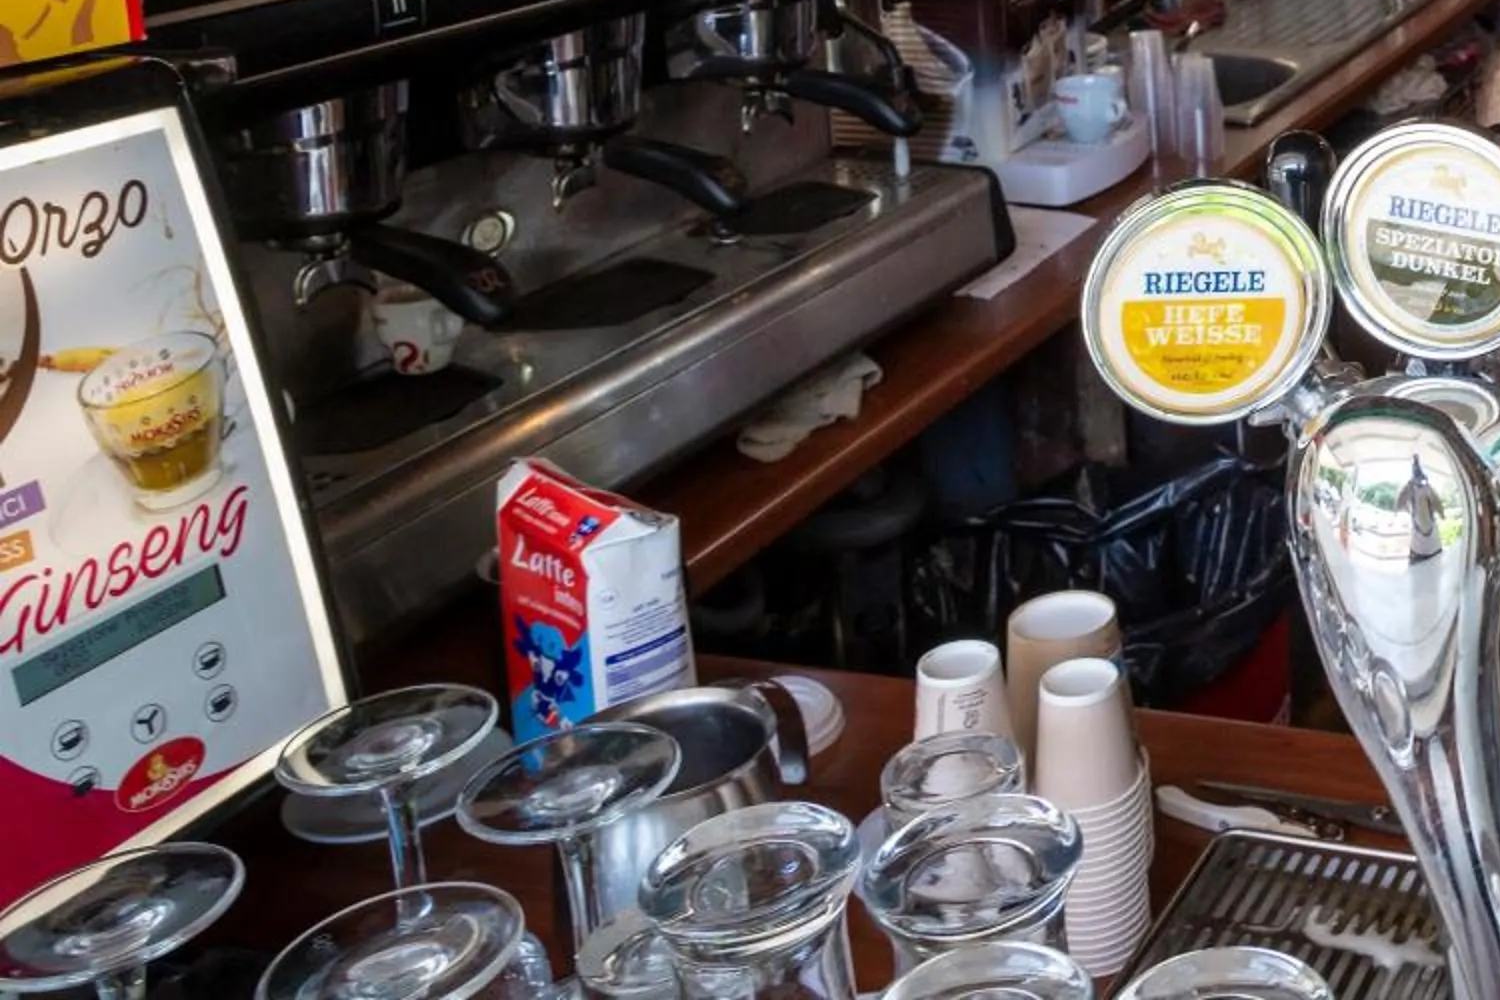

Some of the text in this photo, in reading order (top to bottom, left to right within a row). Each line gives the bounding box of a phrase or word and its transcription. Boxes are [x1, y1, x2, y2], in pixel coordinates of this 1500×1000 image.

[0, 179, 147, 264] Orzo
[1390, 250, 1492, 285] DUNKEL
[1143, 270, 1266, 295] RIEGELE
[1163, 303, 1246, 325] HEFE
[1145, 324, 1263, 348] WEISSE
[0, 493, 27, 519] CI
[511, 533, 576, 588] Latte
